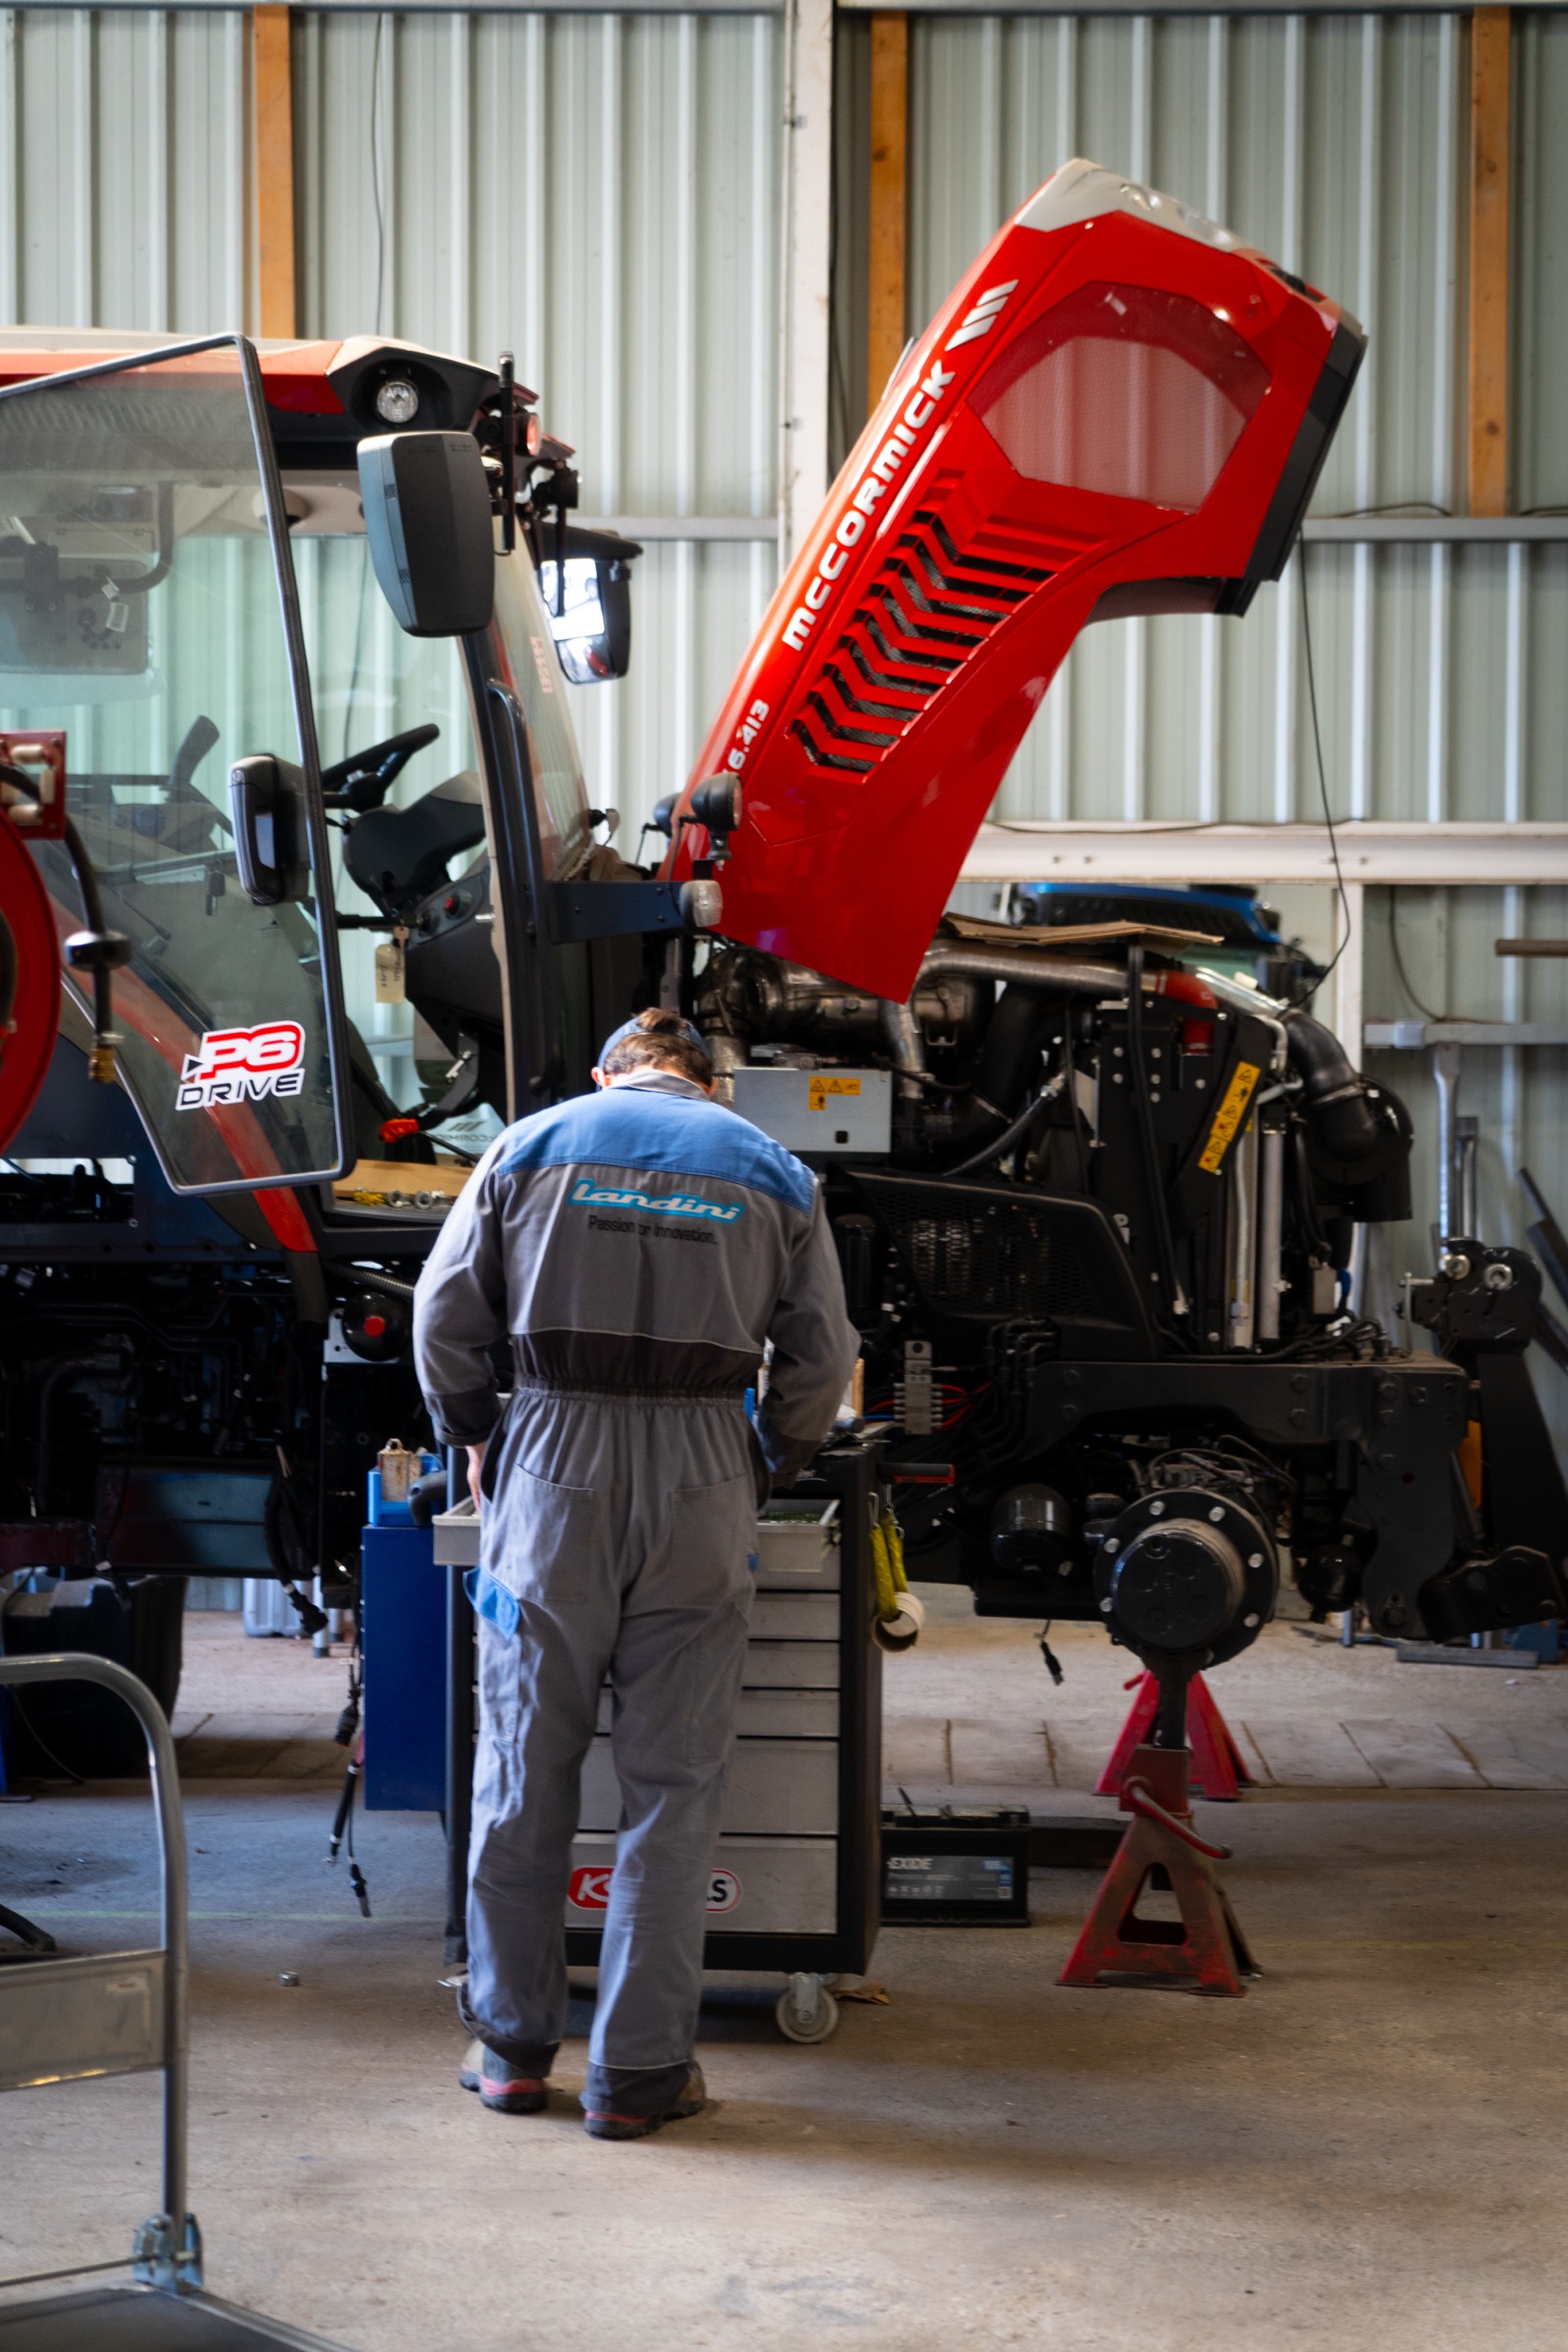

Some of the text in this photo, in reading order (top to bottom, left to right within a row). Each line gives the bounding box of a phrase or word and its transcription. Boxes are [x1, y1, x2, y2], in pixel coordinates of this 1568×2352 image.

[722, 699, 770, 772] 6.413
[199, 1023, 302, 1080] P6
[180, 1072, 300, 1106] DRIVE
[570, 1182, 742, 1221] Landini
[588, 1214, 635, 1234] Passion
